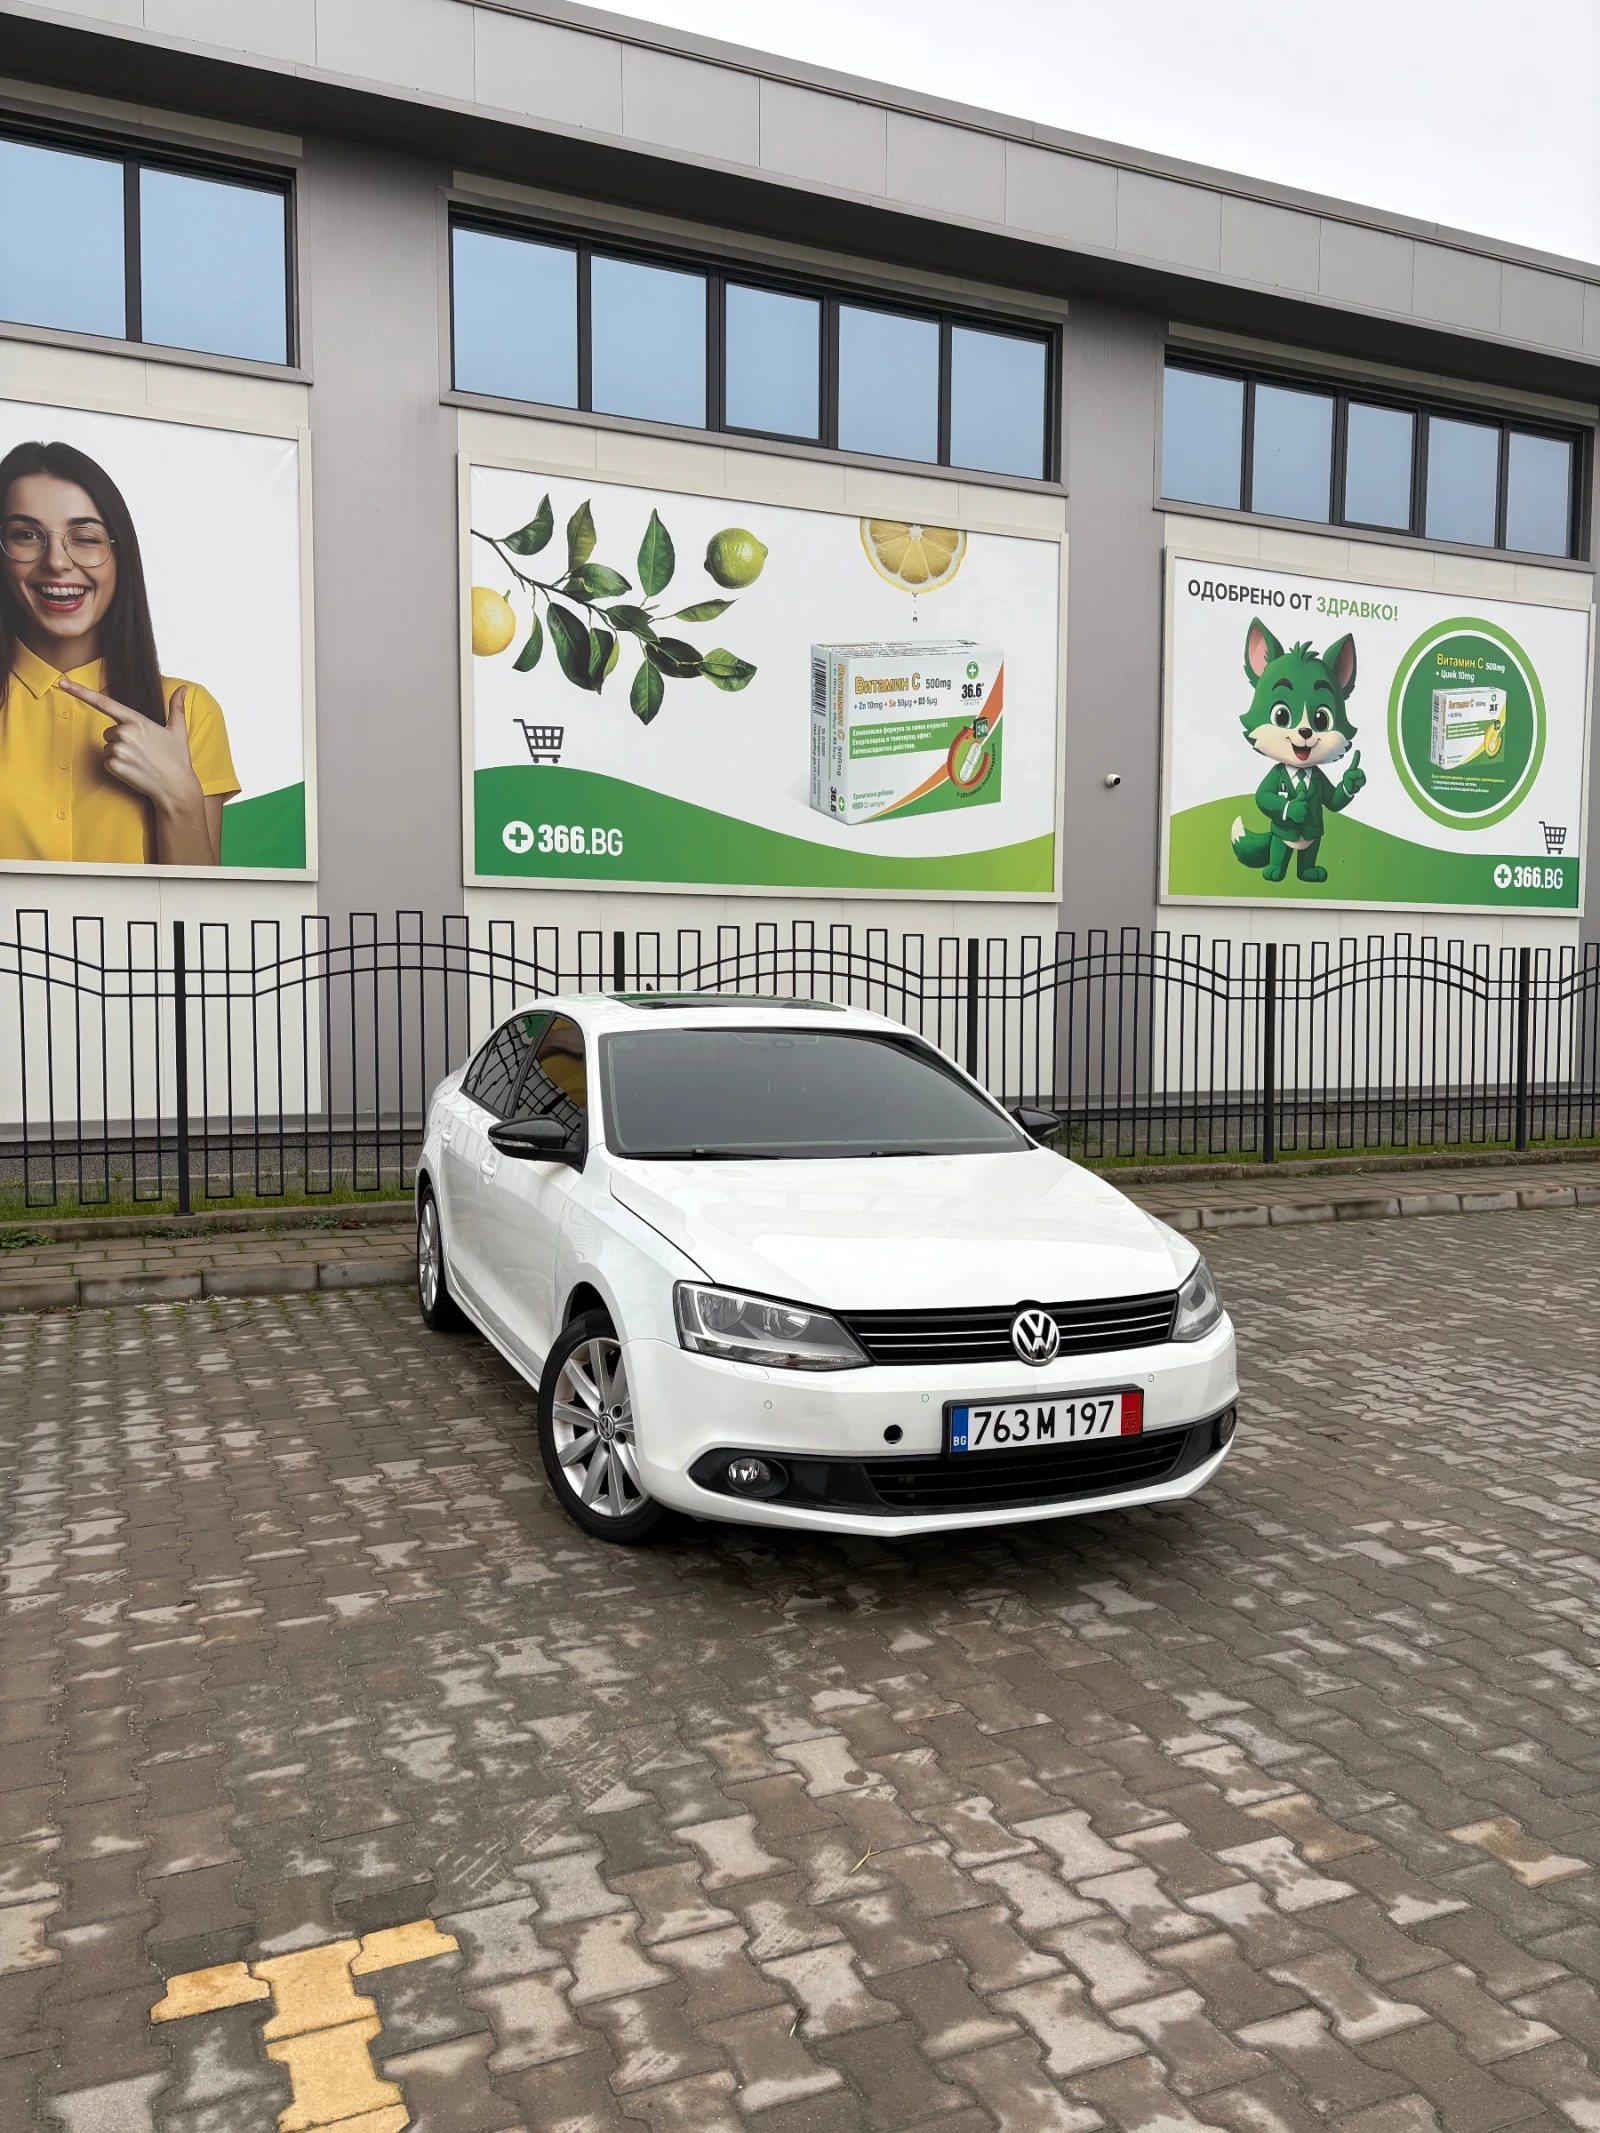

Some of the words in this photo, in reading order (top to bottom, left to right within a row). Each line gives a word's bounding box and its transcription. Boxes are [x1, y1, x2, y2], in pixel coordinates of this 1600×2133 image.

[1187, 579, 1285, 608] ОДОБРЕНО
[1290, 593, 1312, 611] ОТ
[1316, 596, 1398, 621] ЗДРАВКО!
[1437, 653, 1475, 668] Витамин
[1485, 662, 1506, 673] 500mg
[854, 676, 909, 694] Витамин
[925, 678, 952, 690] 500mg
[1458, 671, 1475, 683] 10mg
[867, 701, 883, 711] 10mg
[538, 824, 623, 856] 366.BG
[1513, 866, 1564, 889] 366.BG
[953, 1436, 967, 1446] BG
[974, 1409, 1030, 1445] 763
[1037, 1406, 1056, 1440] M
[1066, 1401, 1115, 1436] 197
